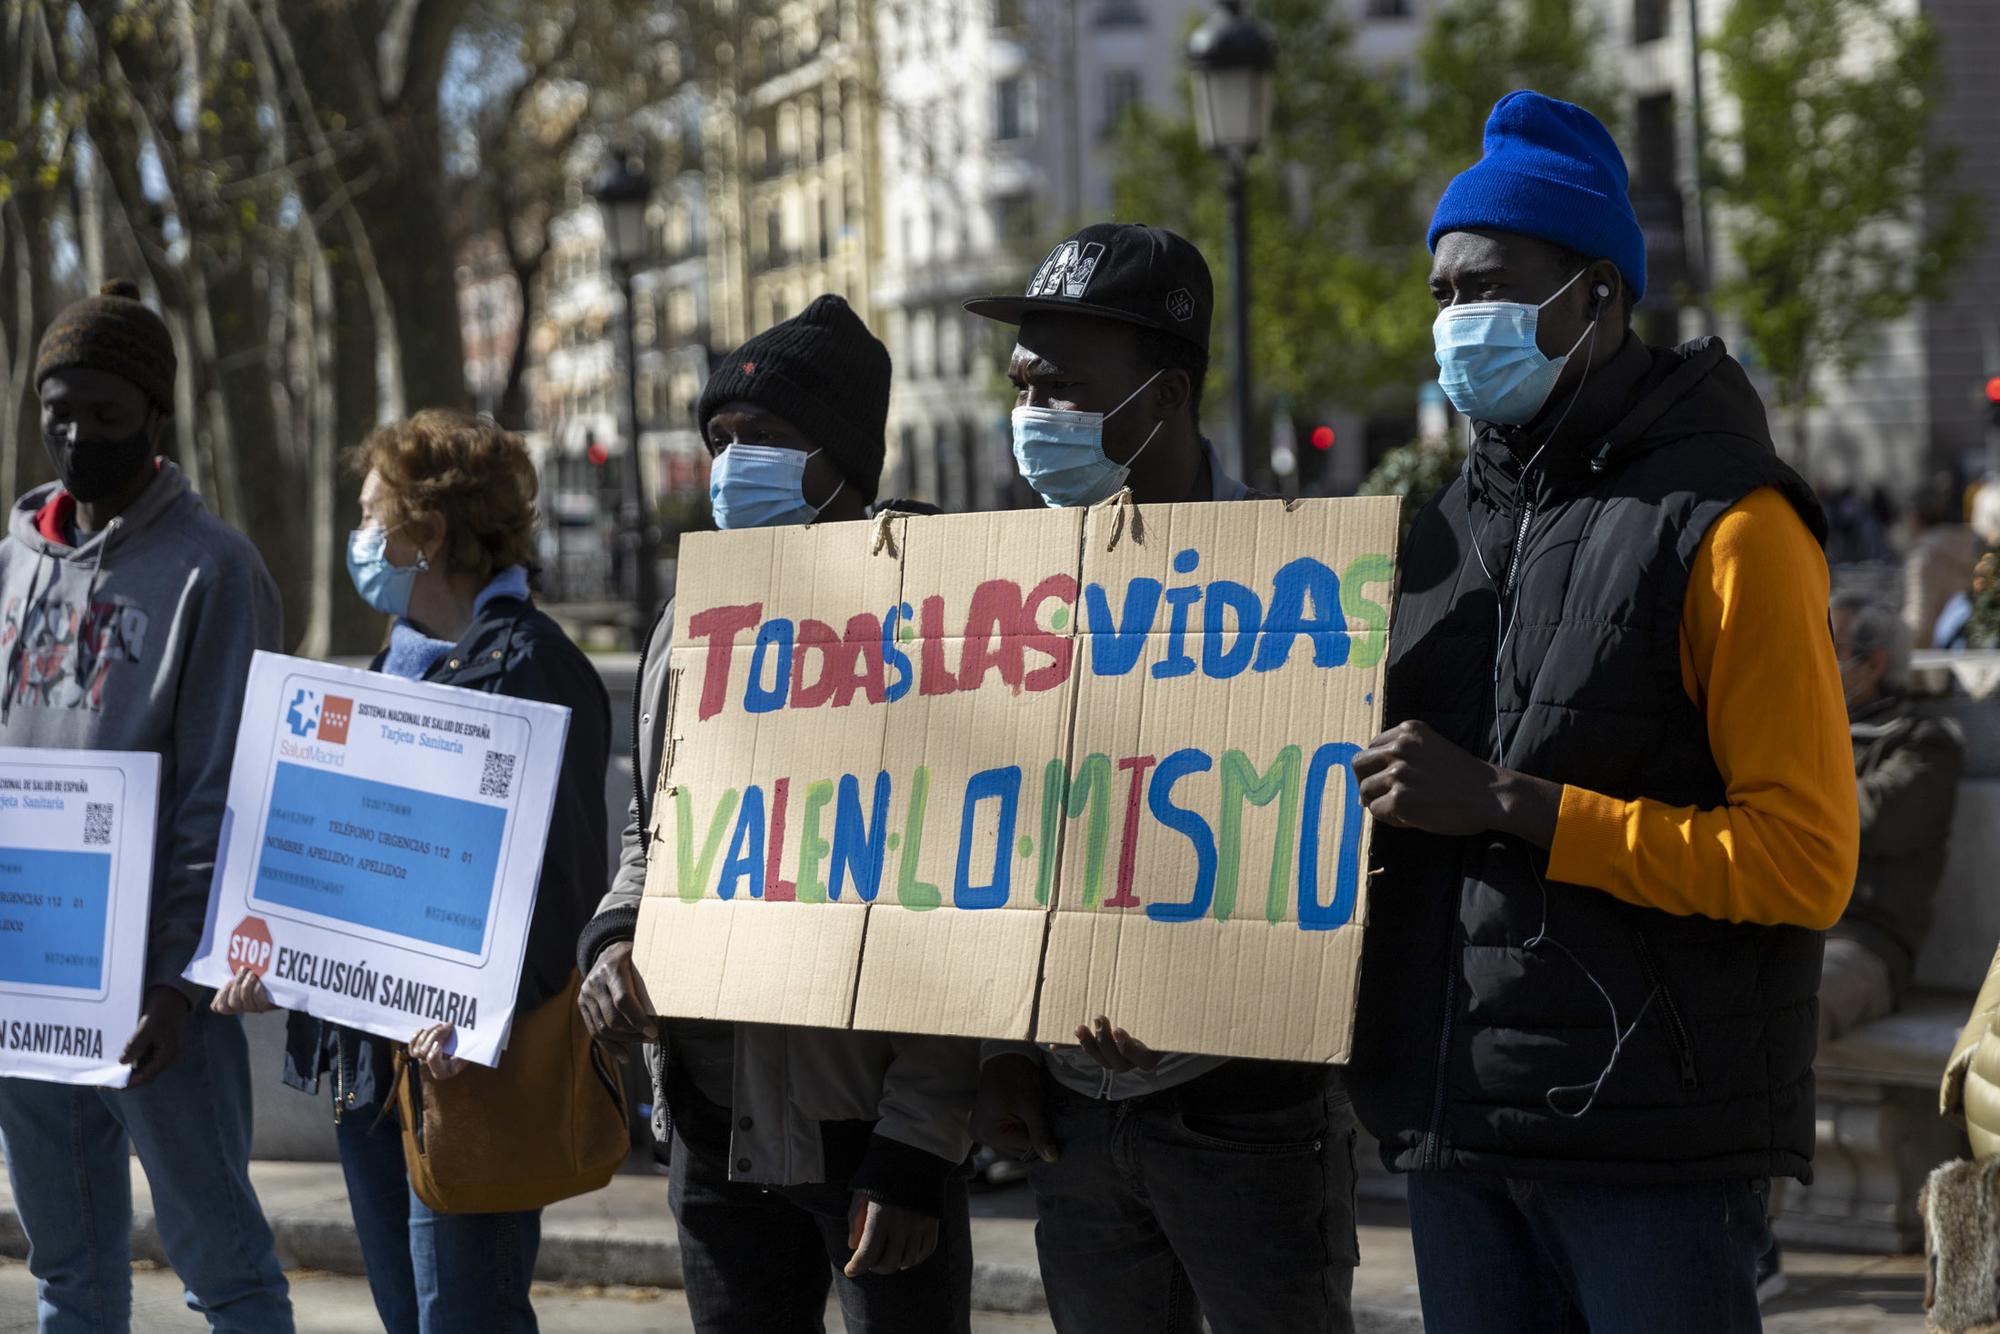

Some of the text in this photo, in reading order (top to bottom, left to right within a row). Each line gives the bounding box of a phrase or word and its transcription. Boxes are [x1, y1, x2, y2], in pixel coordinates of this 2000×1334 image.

[688, 601, 913, 721] TODAS
[918, 573, 1078, 696] LAS
[358, 703, 491, 739] SISTEMA NACIONAL DE SALUD DE ESPAÑA
[380, 725, 464, 754] Tarjeta Sanitaria
[23, 778, 31, 790] DE
[32, 778, 54, 792] SALUD
[55, 780, 62, 792] DE
[63, 778, 88, 793] ESPAÑA
[23, 795, 64, 810] Sanitaria
[328, 817, 375, 841] TELÉFONO
[378, 831, 431, 854] URGENCIAS
[435, 845, 450, 859] 112
[462, 851, 473, 864] 01
[674, 742, 1364, 931] VALEN LO MISMO
[266, 835, 407, 879] NOMBRE APELLIDO1 APELLIDO2
[48, 896, 62, 907] 112
[230, 934, 271, 967] STOP
[275, 947, 478, 1030] EXCLUSIÓN SANITARIA
[10, 1020, 103, 1059] SANITARIA
